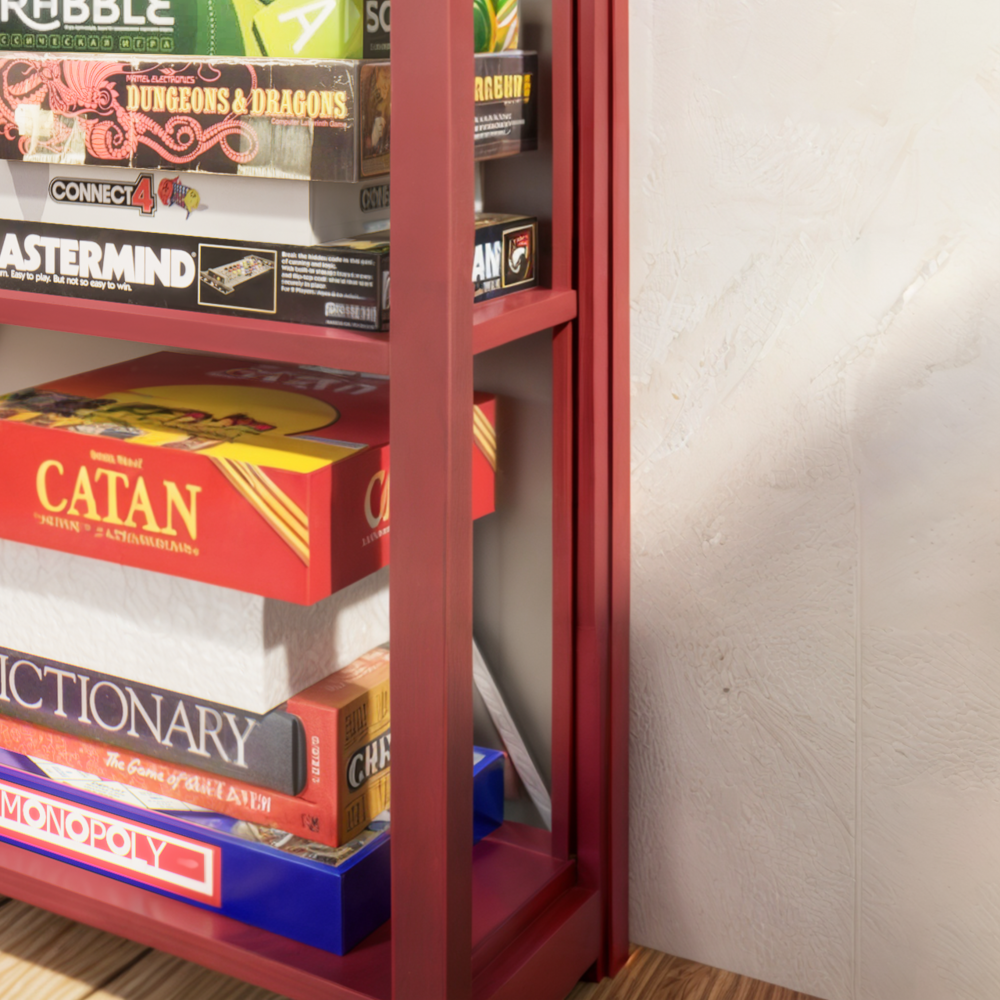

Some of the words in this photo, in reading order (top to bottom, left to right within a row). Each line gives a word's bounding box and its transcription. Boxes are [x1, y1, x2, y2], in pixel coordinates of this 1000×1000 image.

[126, 84, 230, 115] DUNGEONS
[232, 88, 248, 115] &
[250, 88, 348, 119] DRAGONS
[52, 181, 133, 206] CONNECT
[132, 178, 153, 213] 4
[11, 269, 25, 281] Easy
[27, 272, 34, 280] to
[35, 273, 51, 284] play.
[53, 274, 65, 284] But
[66, 276, 79, 285] not
[79, 278, 89, 287] so
[90, 280, 106, 290] easy
[107, 281, 116, 290] to
[117, 282, 132, 291] win.
[36, 459, 202, 540] CATAN
[107, 751, 125, 770] The
[127, 758, 164, 783] Game
[166, 770, 187, 790] of
[1, 790, 168, 869] MONOPOLY
